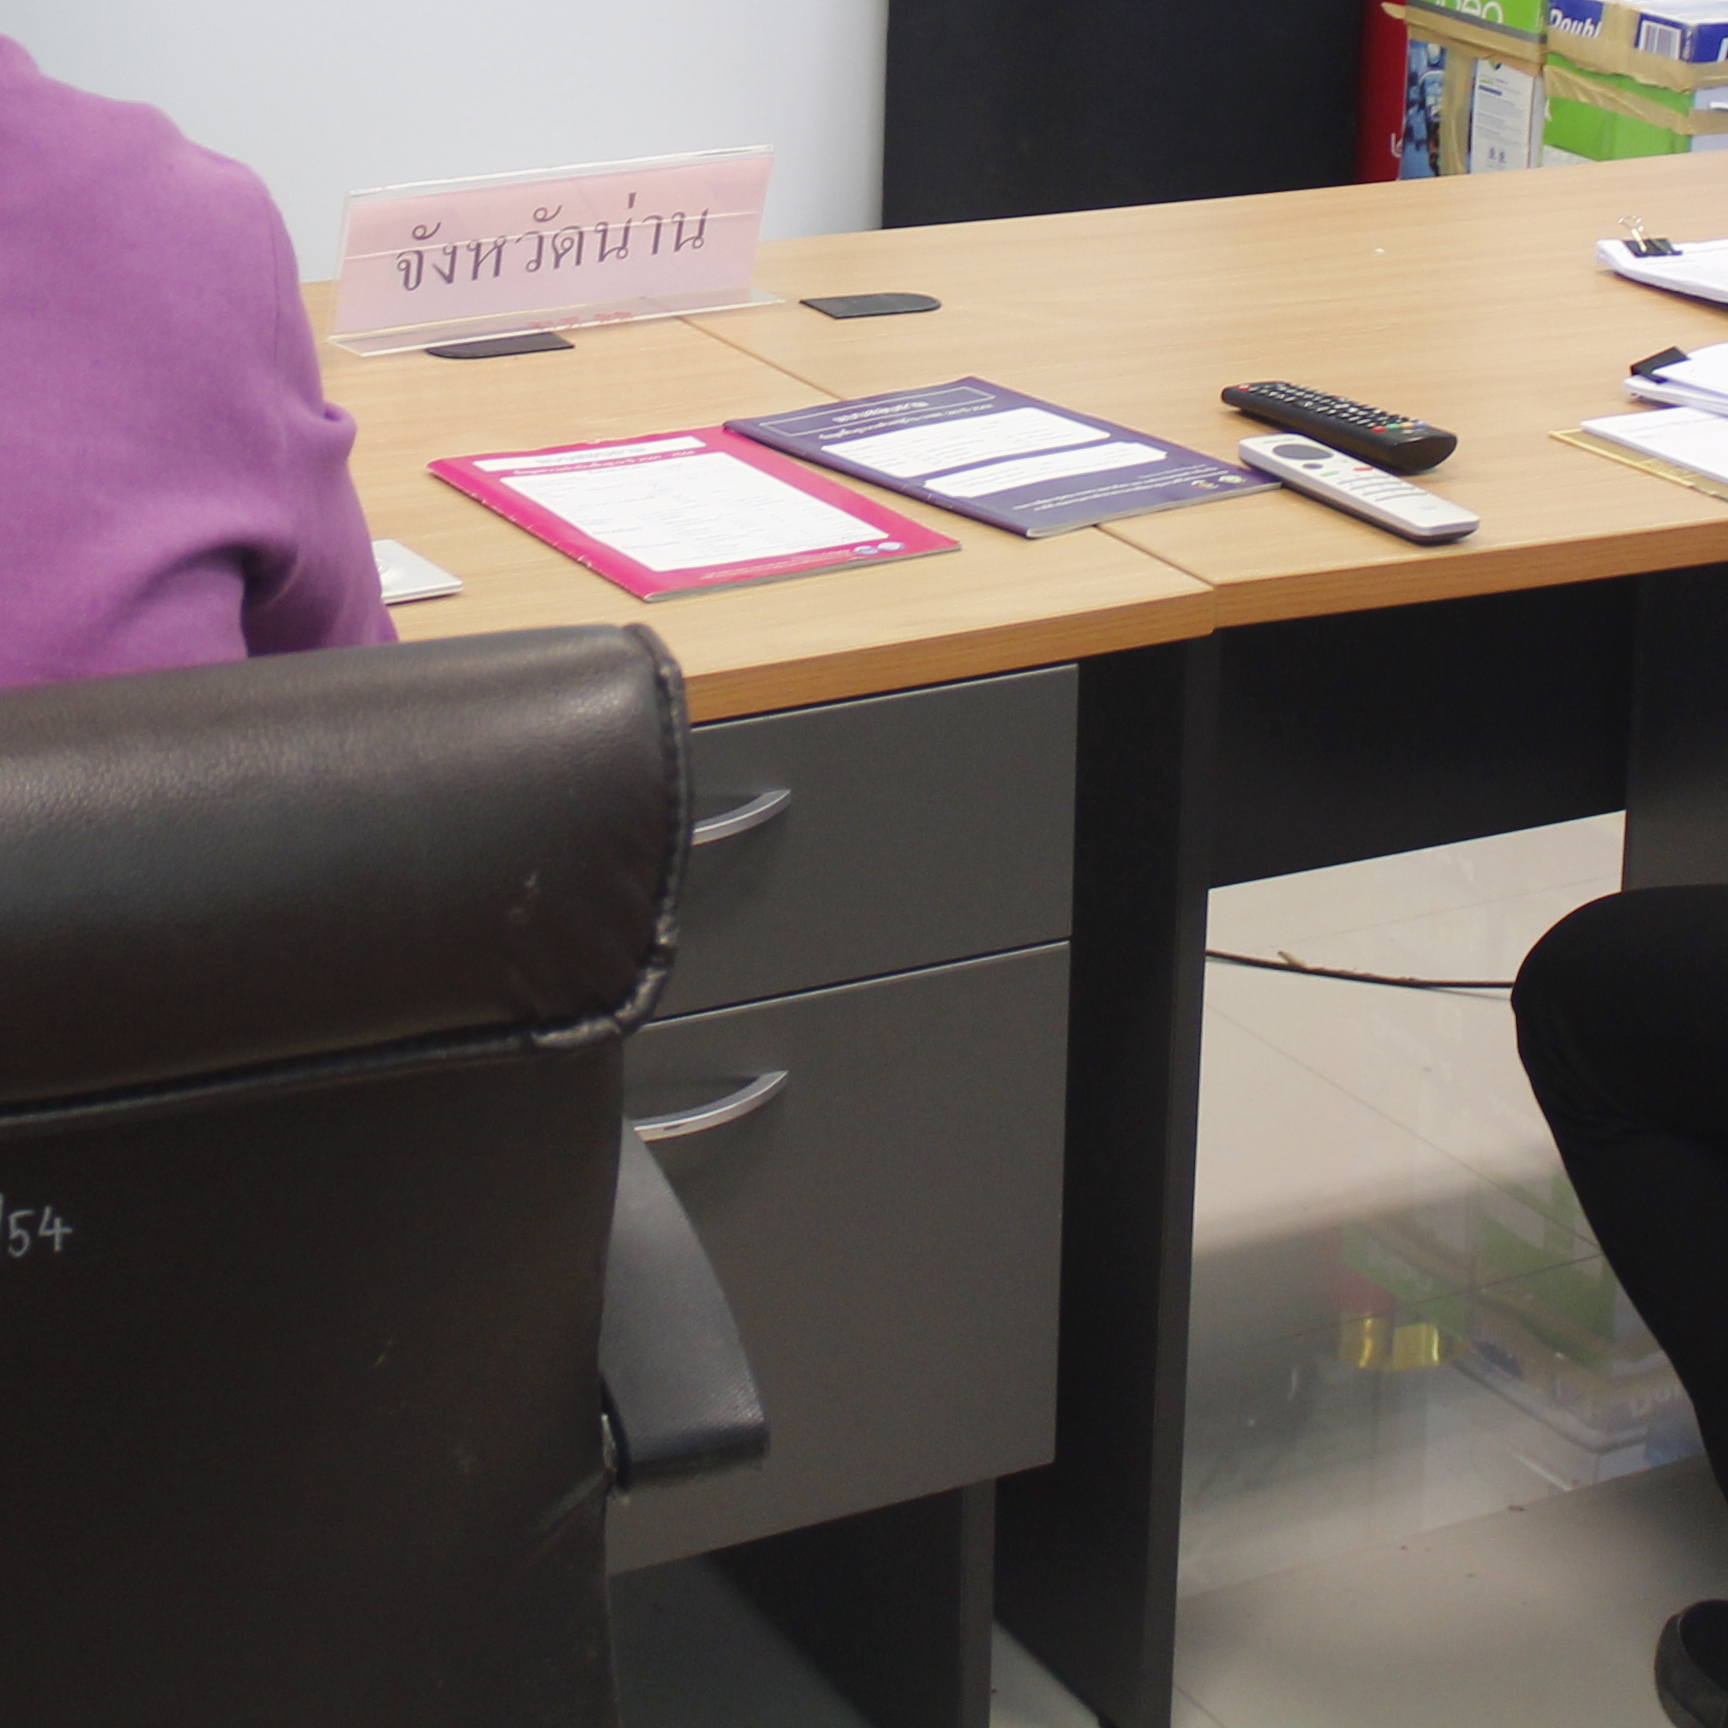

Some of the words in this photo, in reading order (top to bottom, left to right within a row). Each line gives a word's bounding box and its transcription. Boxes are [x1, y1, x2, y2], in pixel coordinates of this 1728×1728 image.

[1550, 9, 1602, 38] Doubl
[396, 191, 710, 292] จังหวัดน่าน
